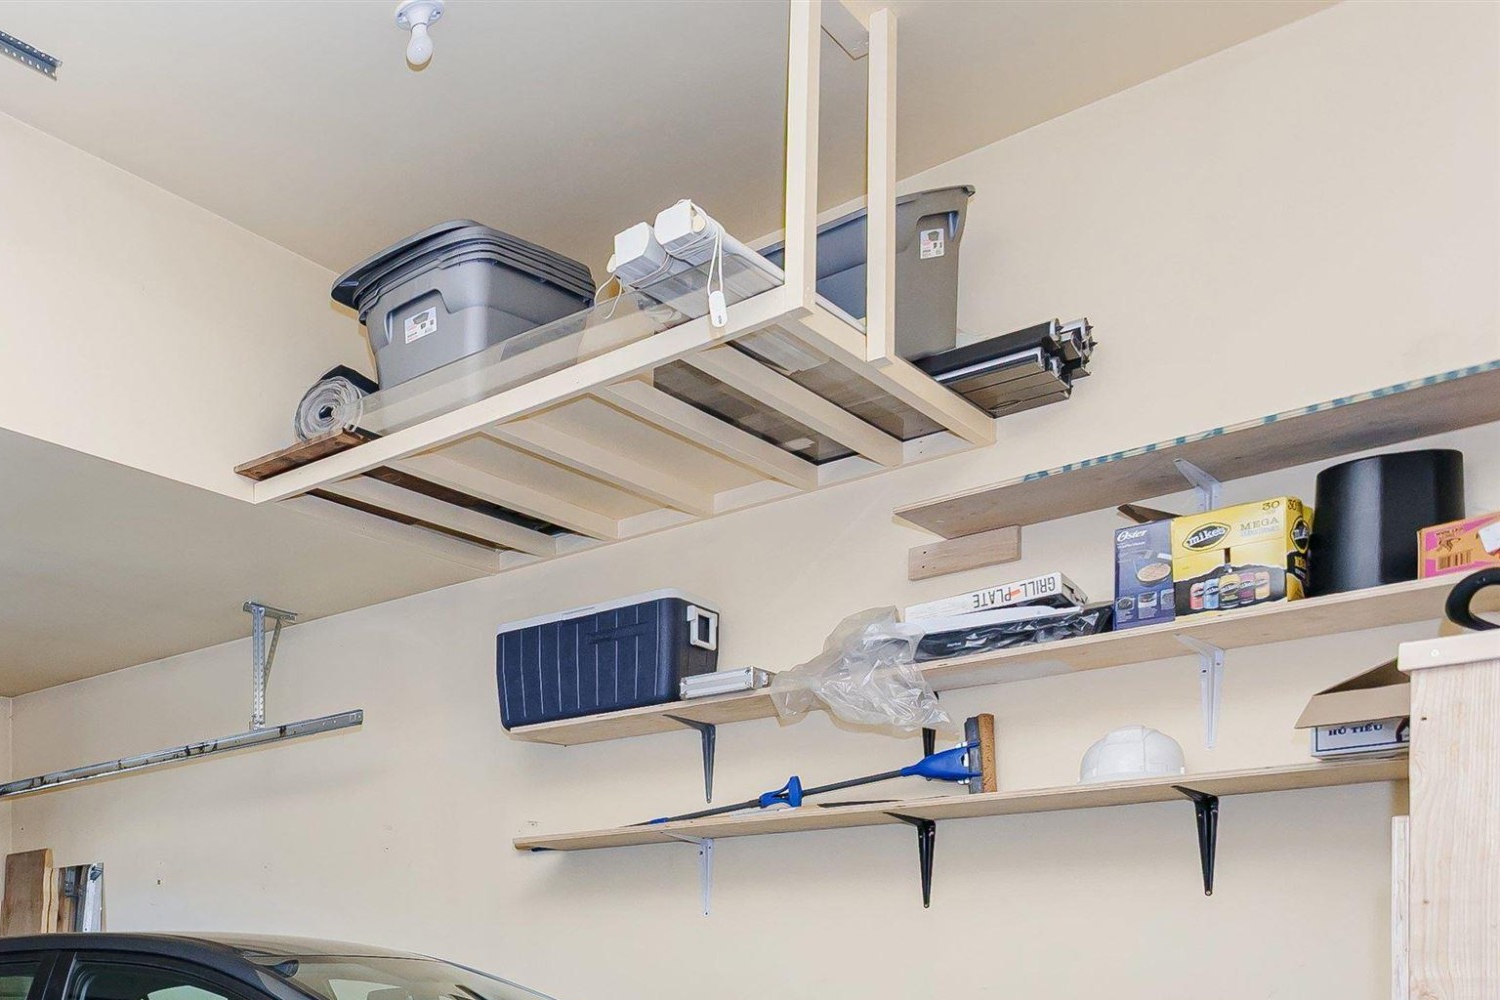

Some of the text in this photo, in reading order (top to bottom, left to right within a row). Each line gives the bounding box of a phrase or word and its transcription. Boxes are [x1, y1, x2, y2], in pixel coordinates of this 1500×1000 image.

[1262, 500, 1280, 511] 30
[1240, 516, 1280, 531] MEGA
[1116, 529, 1148, 543] Oster
[972, 575, 1057, 609] GRILL PLATE
